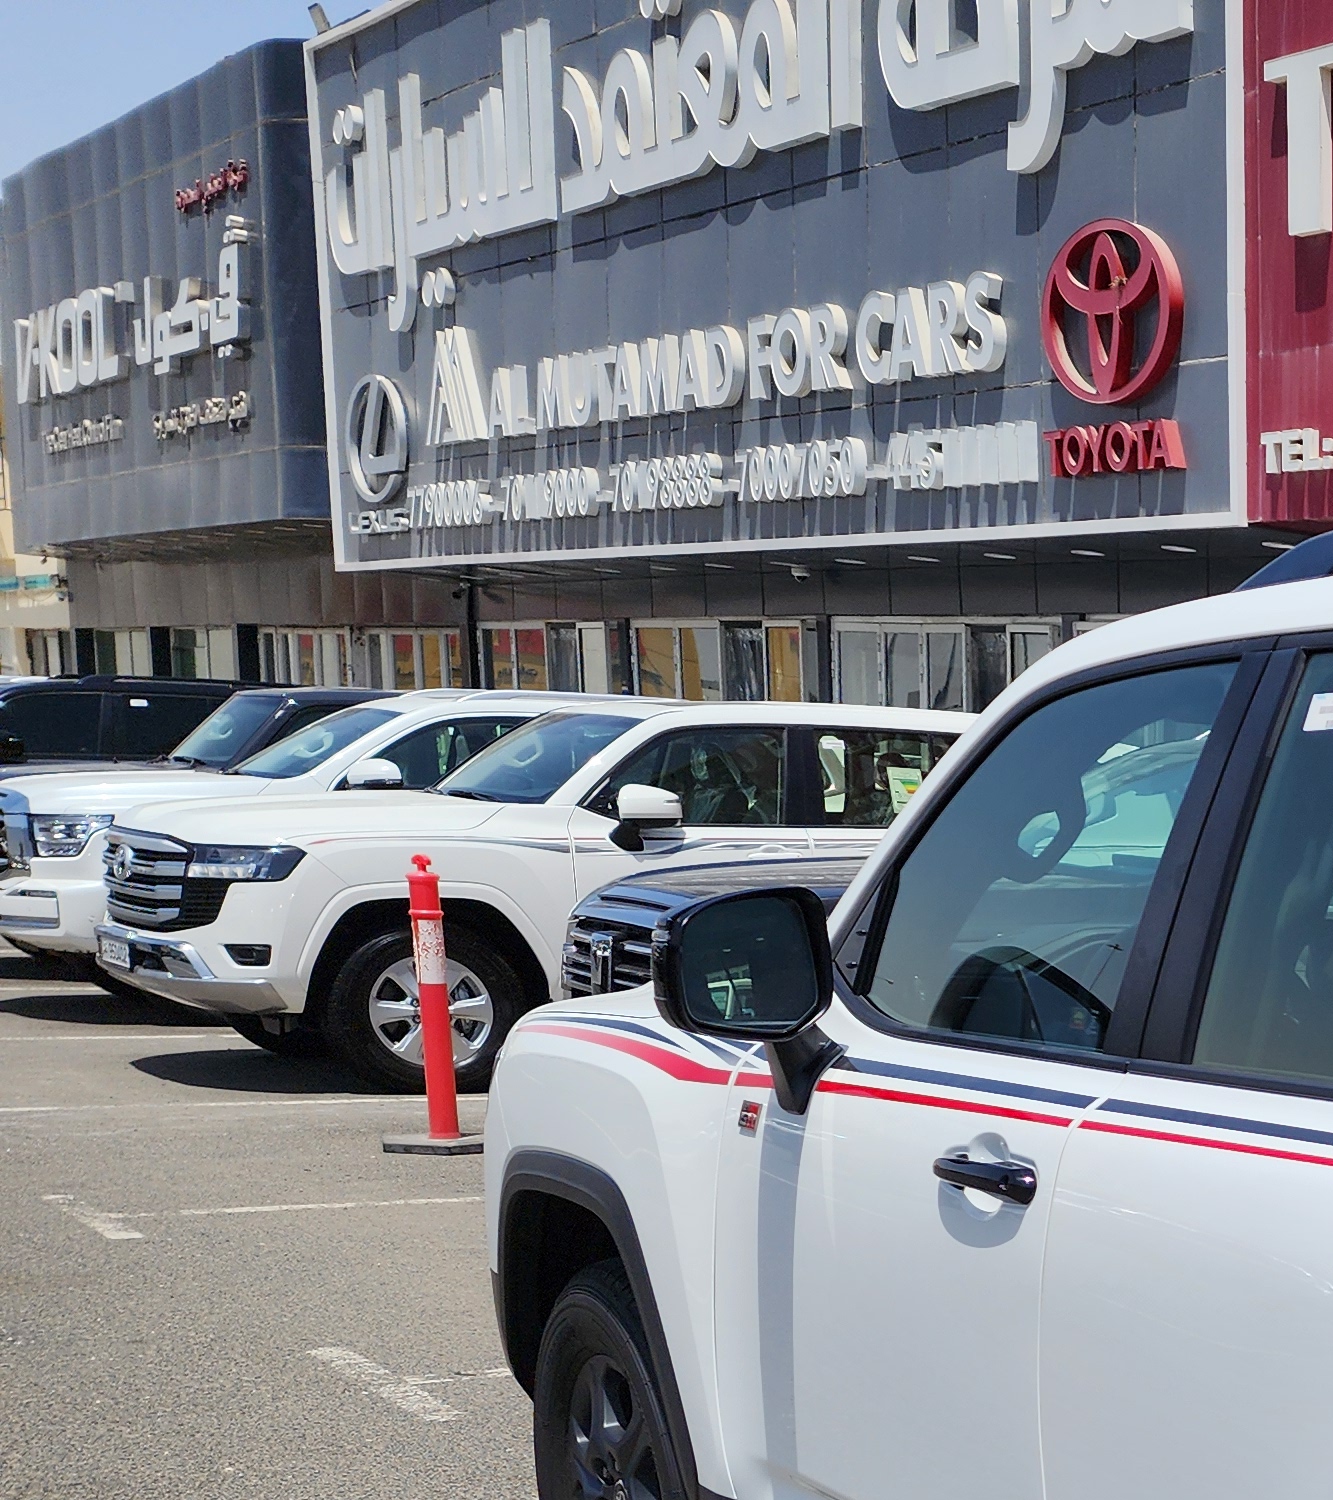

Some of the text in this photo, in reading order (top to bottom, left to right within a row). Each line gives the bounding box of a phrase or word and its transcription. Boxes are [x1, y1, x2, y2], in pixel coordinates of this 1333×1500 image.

[13, 284, 122, 404] V-KOOL
[488, 269, 1007, 437] AL MUTAMAD FOR CARS
[1043, 418, 1187, 477] TOYOTA
[348, 507, 411, 535] LEXUS
